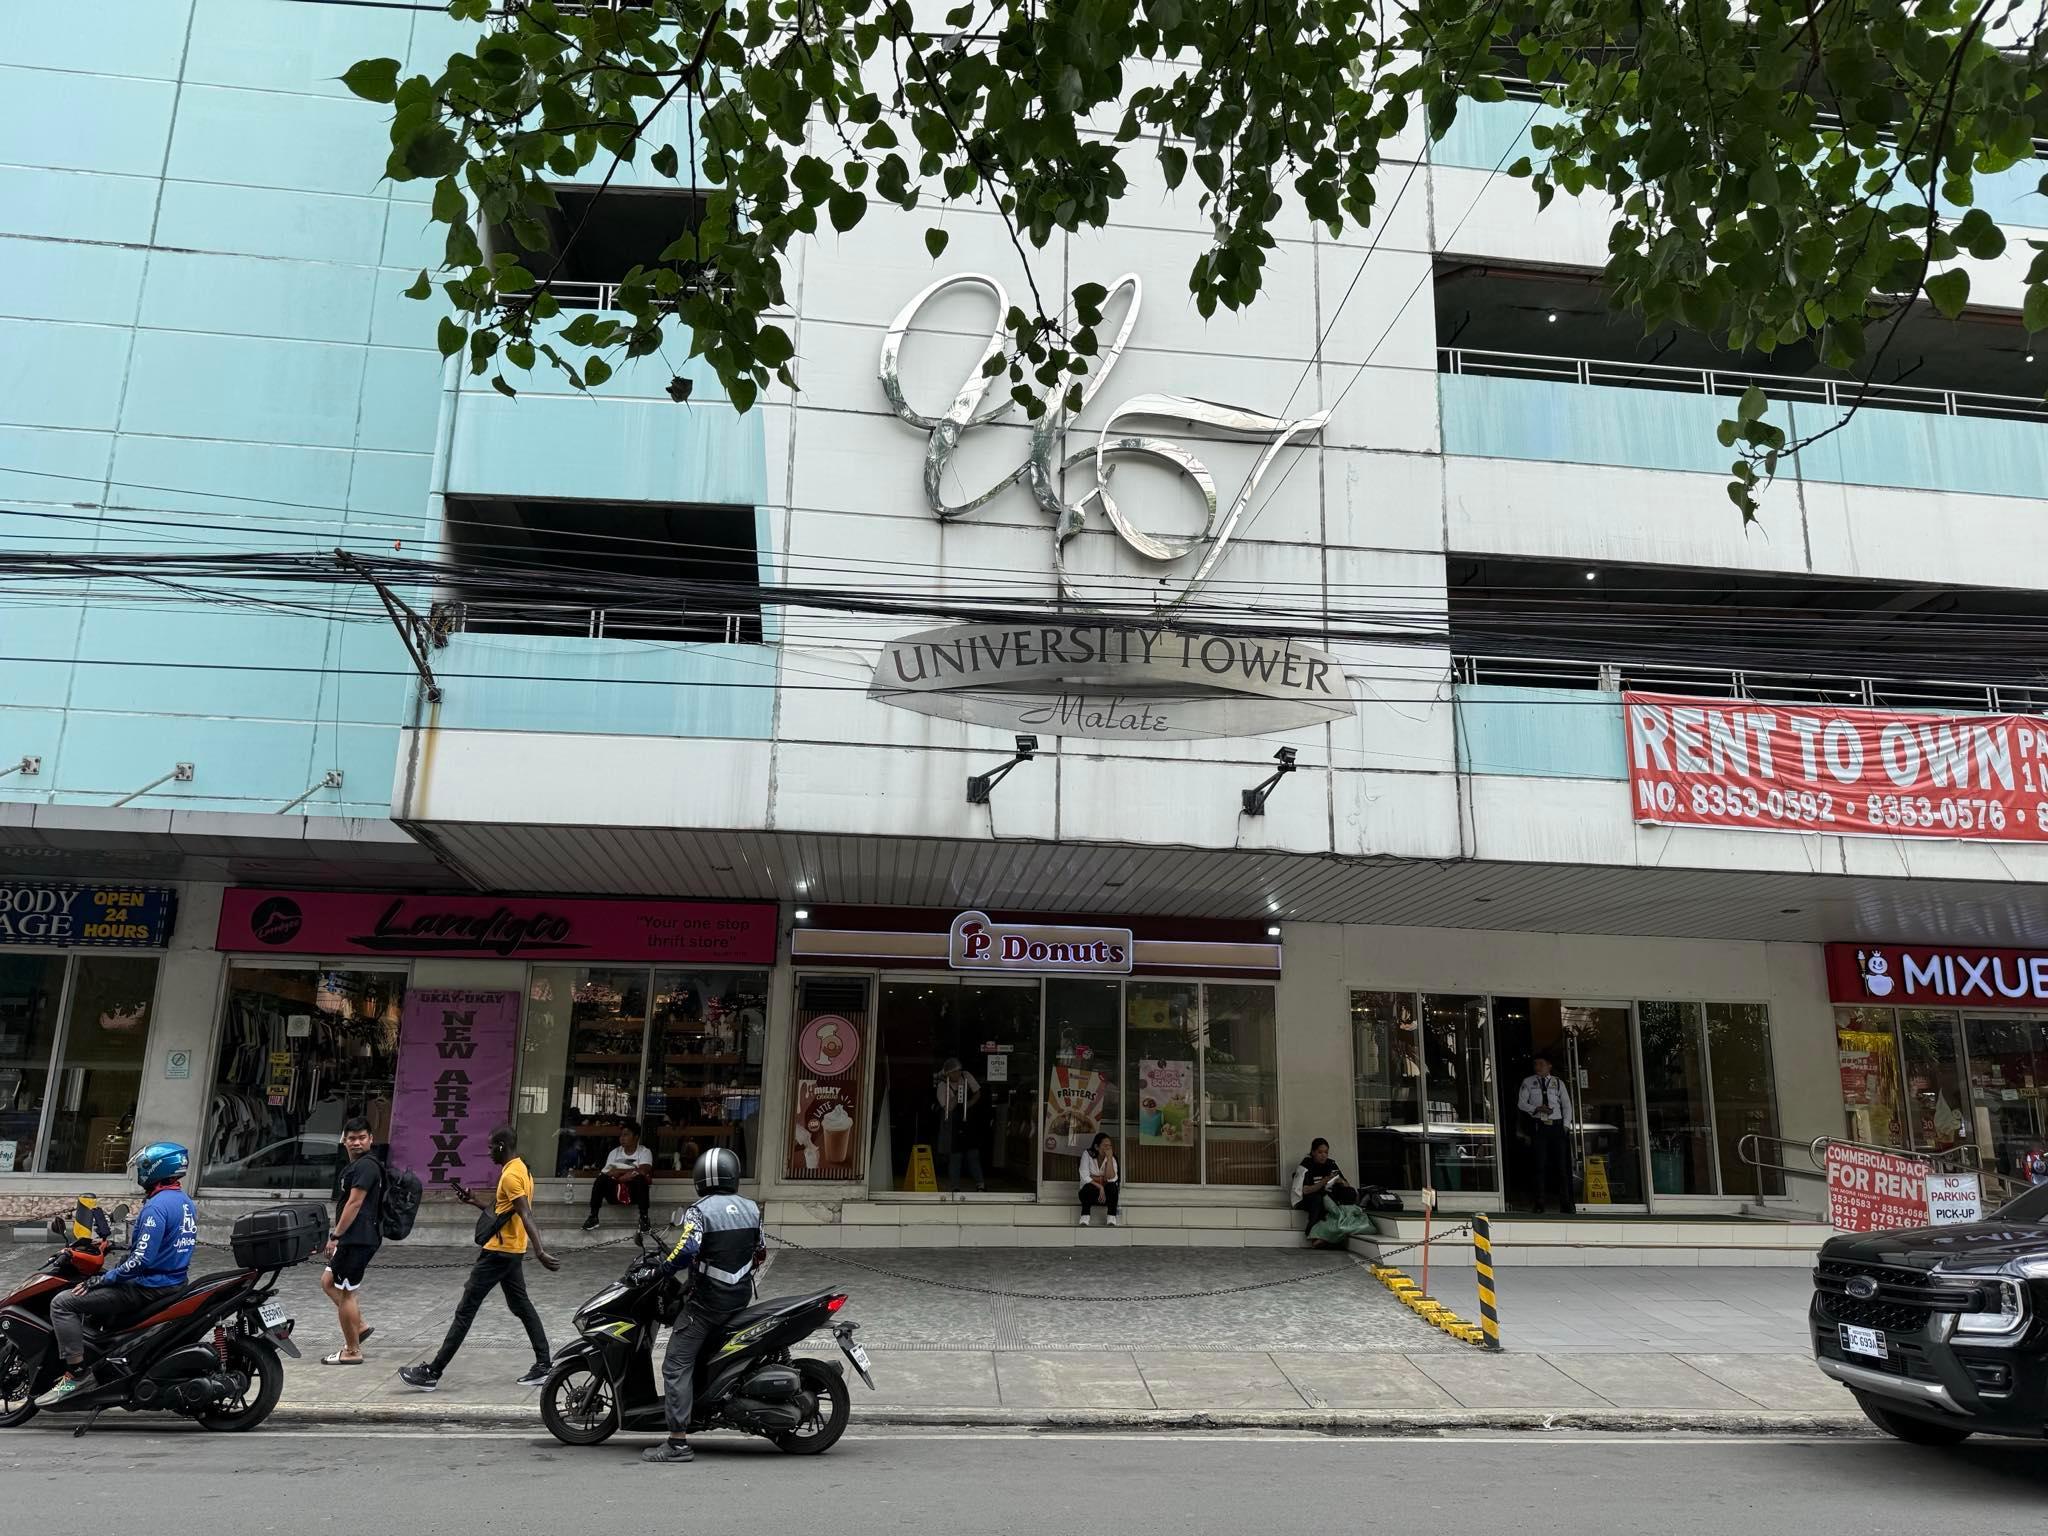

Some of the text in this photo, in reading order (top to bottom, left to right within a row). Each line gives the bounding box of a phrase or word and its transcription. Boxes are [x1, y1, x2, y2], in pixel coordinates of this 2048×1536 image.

[892, 625, 1333, 695] UNIVERSITY TOWER
[1019, 692, 1170, 732] Malate
[1632, 704, 2016, 792] RENT TO OWN
[1638, 779, 1685, 814] NO.
[1691, 783, 1837, 824] 8353-0592
[1866, 794, 2008, 832] 8353-0576
[0, 888, 80, 915] BODY
[93, 891, 145, 907] OPEN
[105, 908, 128, 922] 24
[683, 919, 711, 930] one
[717, 918, 750, 933] stop
[83, 923, 149, 939] HOURS
[648, 934, 684, 948] thrift
[1001, 935, 1125, 963] Donuts
[1902, 953, 2048, 999] MIXUE
[435, 1010, 478, 1060] NEW
[813, 1101, 832, 1118] LATTE
[427, 1069, 473, 1184] ARRIVAL
[1828, 1146, 1893, 1172] COMMERCIAL
[1828, 1162, 1927, 1202] FOR RENT
[1944, 1178, 1959, 1188] NO
[1832, 1193, 1871, 1208] 353-0583
[1931, 1191, 1975, 1202] PARKING
[1936, 1208, 1975, 1218] PICK-UP
